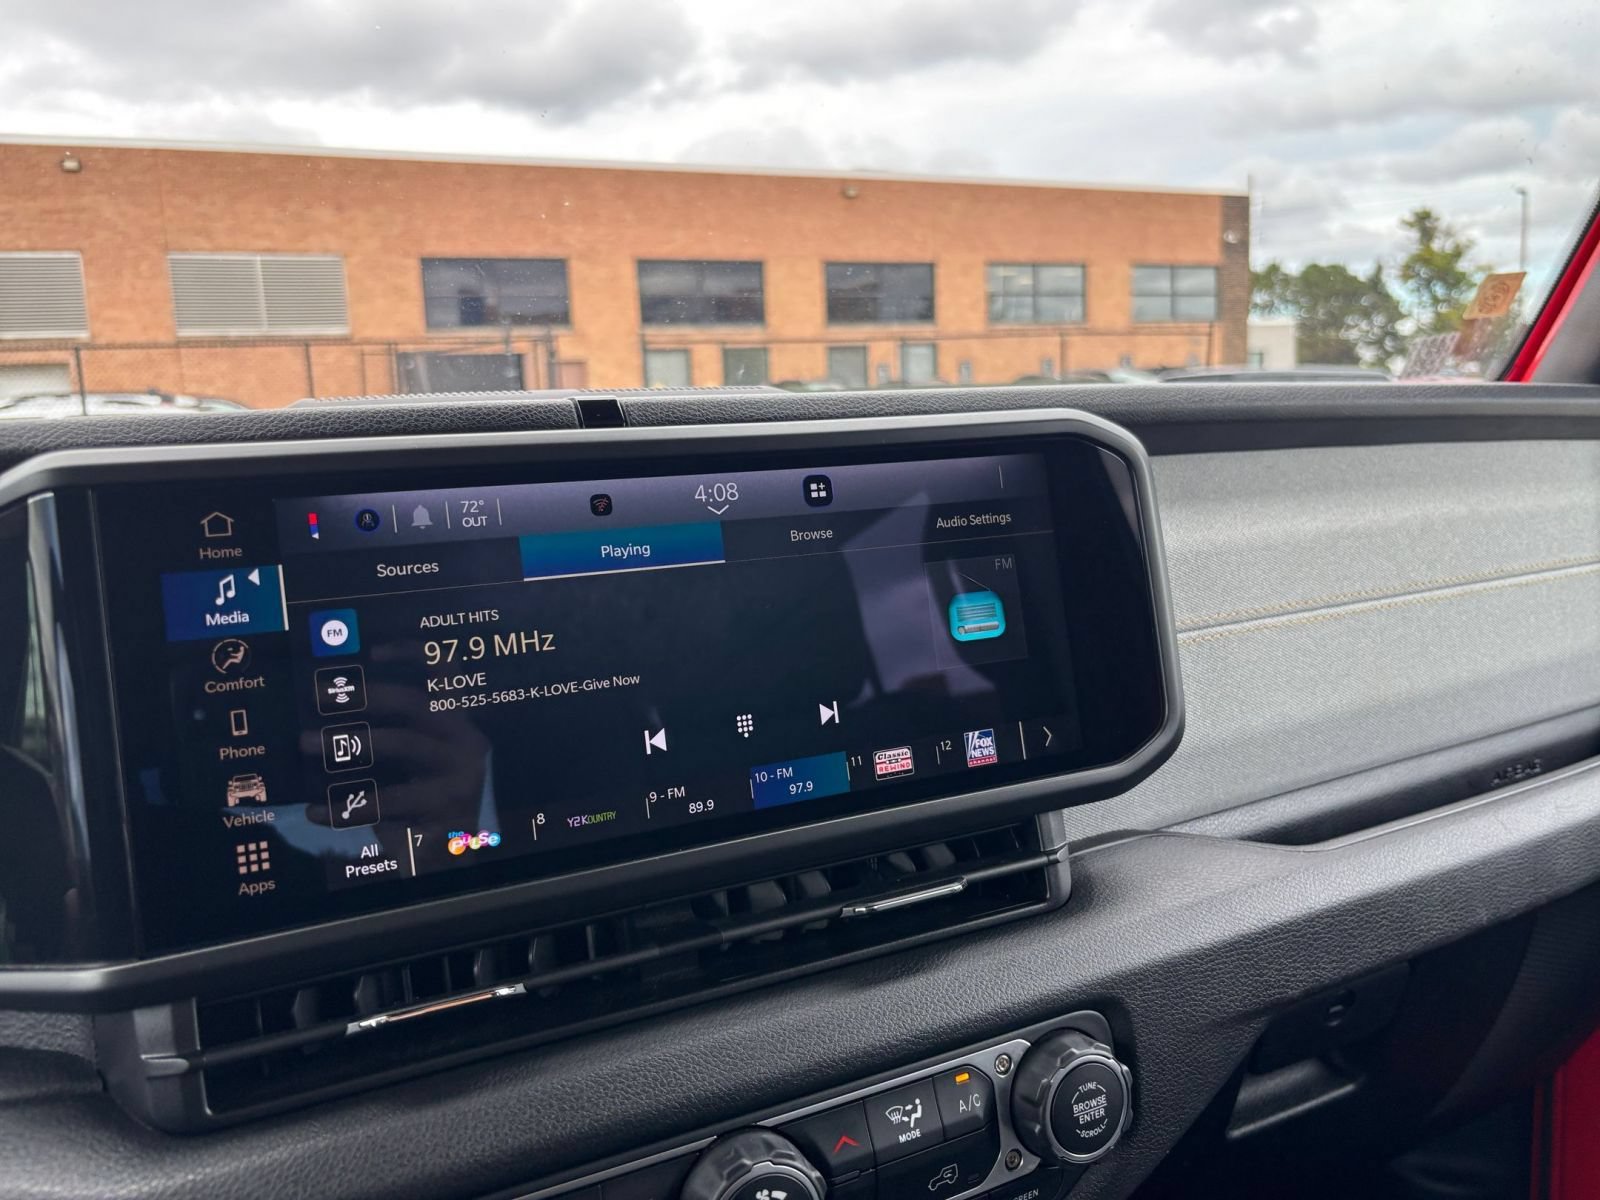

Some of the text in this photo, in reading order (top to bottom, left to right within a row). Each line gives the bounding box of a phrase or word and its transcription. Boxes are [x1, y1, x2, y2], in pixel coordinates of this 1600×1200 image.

[694, 482, 739, 503] 4:08
[460, 499, 485, 514] 72°
[462, 515, 488, 528] OUT
[936, 511, 1012, 529] Audio Settings
[790, 527, 833, 542] Browse
[200, 545, 243, 560] Home
[601, 543, 651, 559] Playing
[376, 560, 440, 578] Sources
[994, 557, 1013, 571] FM
[205, 610, 250, 627] Media
[419, 609, 500, 629] ADULT HITS
[326, 628, 343, 638] FM
[423, 629, 556, 666] 97.9 MHz
[204, 675, 265, 694] Comfort
[426, 672, 487, 693] K-LOVE
[428, 674, 641, 713] 800-525-5683-K-LOVE-Give Now
[940, 740, 952, 751] 12
[975, 736, 994, 749] FOX
[218, 743, 266, 760] Phone
[876, 749, 910, 761] Classic
[970, 746, 996, 759] NEWS
[850, 755, 863, 767] 11
[878, 761, 912, 773] REWIND
[754, 771, 769, 784] 10
[776, 766, 794, 780] FM
[649, 792, 657, 803] 9
[667, 786, 686, 800] FM
[788, 780, 814, 796] 97.9
[688, 799, 714, 814] 89.9
[222, 809, 275, 828] Vehicle
[536, 812, 546, 826] 8
[413, 833, 424, 848] 7
[360, 843, 379, 859] All
[345, 857, 399, 879] Presets
[238, 879, 276, 896] Apps
[1079, 1081, 1098, 1092] TUNE
[959, 1092, 982, 1113] A/C
[1073, 1095, 1107, 1113] BROWSE
[1078, 1107, 1106, 1125] ENTER
[898, 1128, 922, 1143] MODE
[1080, 1124, 1106, 1138] SCROLL
